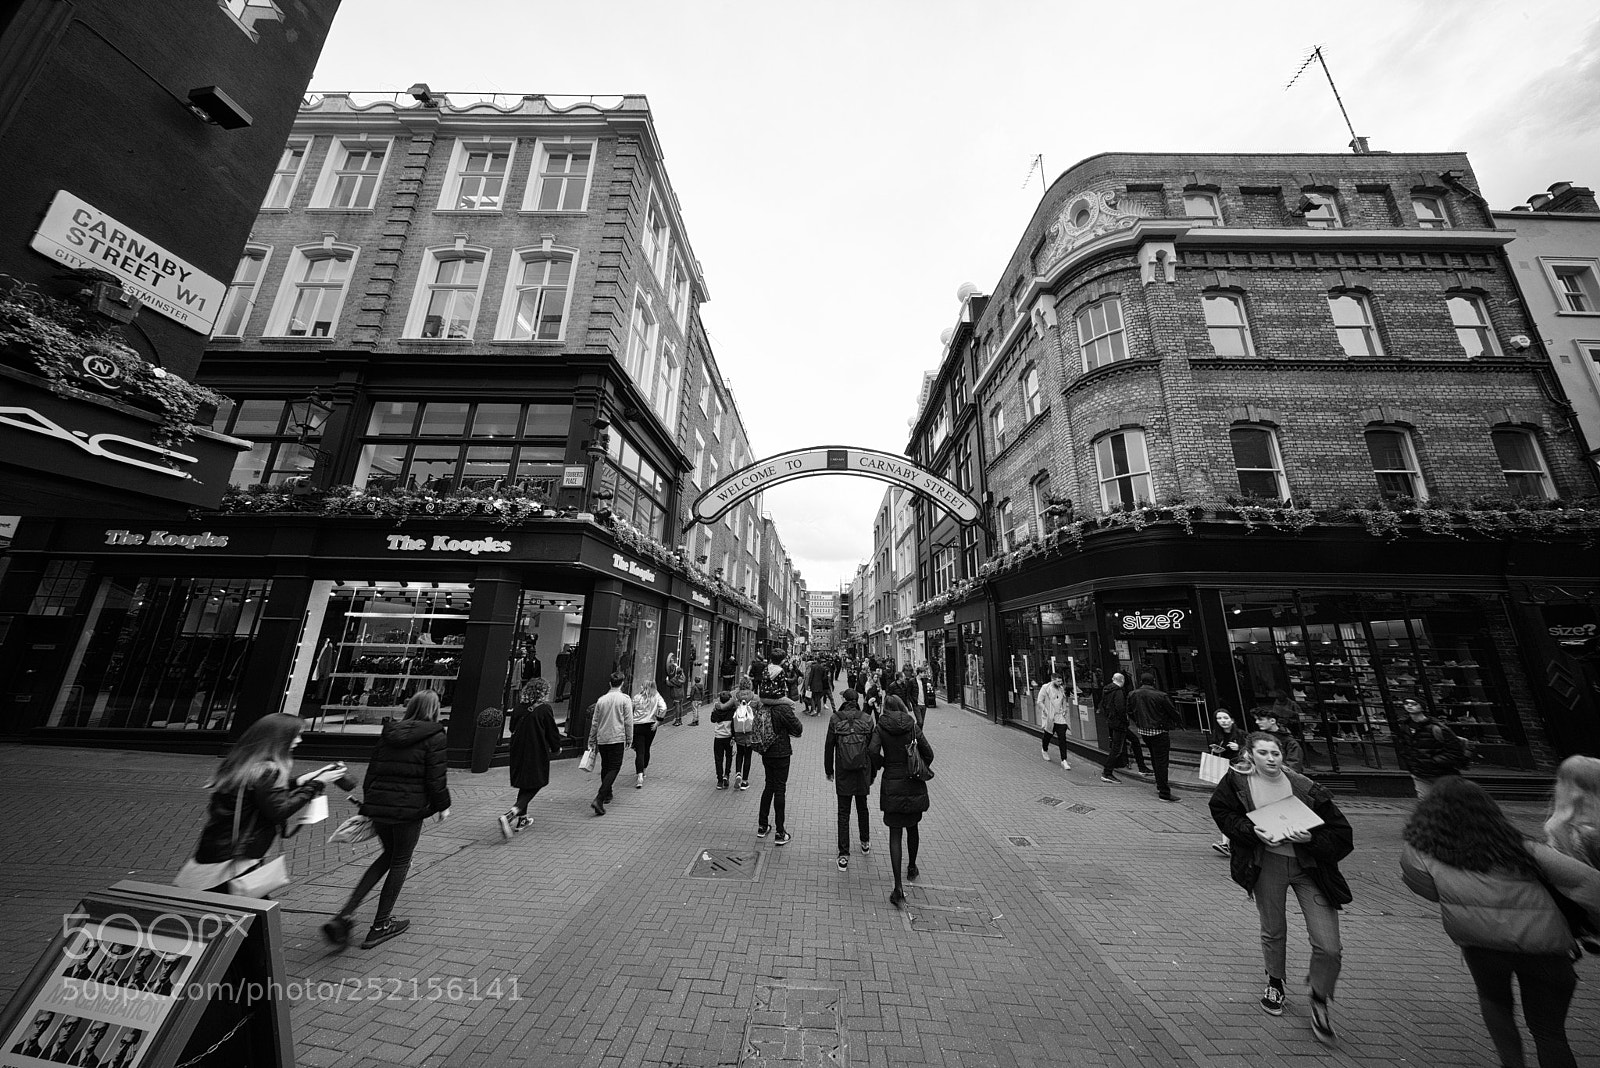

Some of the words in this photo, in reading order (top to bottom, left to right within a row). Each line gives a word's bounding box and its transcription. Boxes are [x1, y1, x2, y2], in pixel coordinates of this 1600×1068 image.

[72, 208, 192, 283] CARNABY
[66, 227, 165, 287] STREET
[175, 284, 207, 312] W1
[55, 249, 87, 267] CITY
[121, 282, 188, 321] ESTMINSTER
[716, 465, 777, 502] WELCOME
[785, 459, 802, 470] TO
[859, 457, 920, 481] CARNABY
[923, 478, 967, 511] STREET
[104, 529, 145, 545] The
[146, 530, 229, 549] Kooples
[386, 534, 427, 551] The
[431, 535, 512, 555] Kooples
[612, 553, 629, 571] The
[1122, 609, 1185, 630] size?
[1548, 623, 1597, 636] size?
